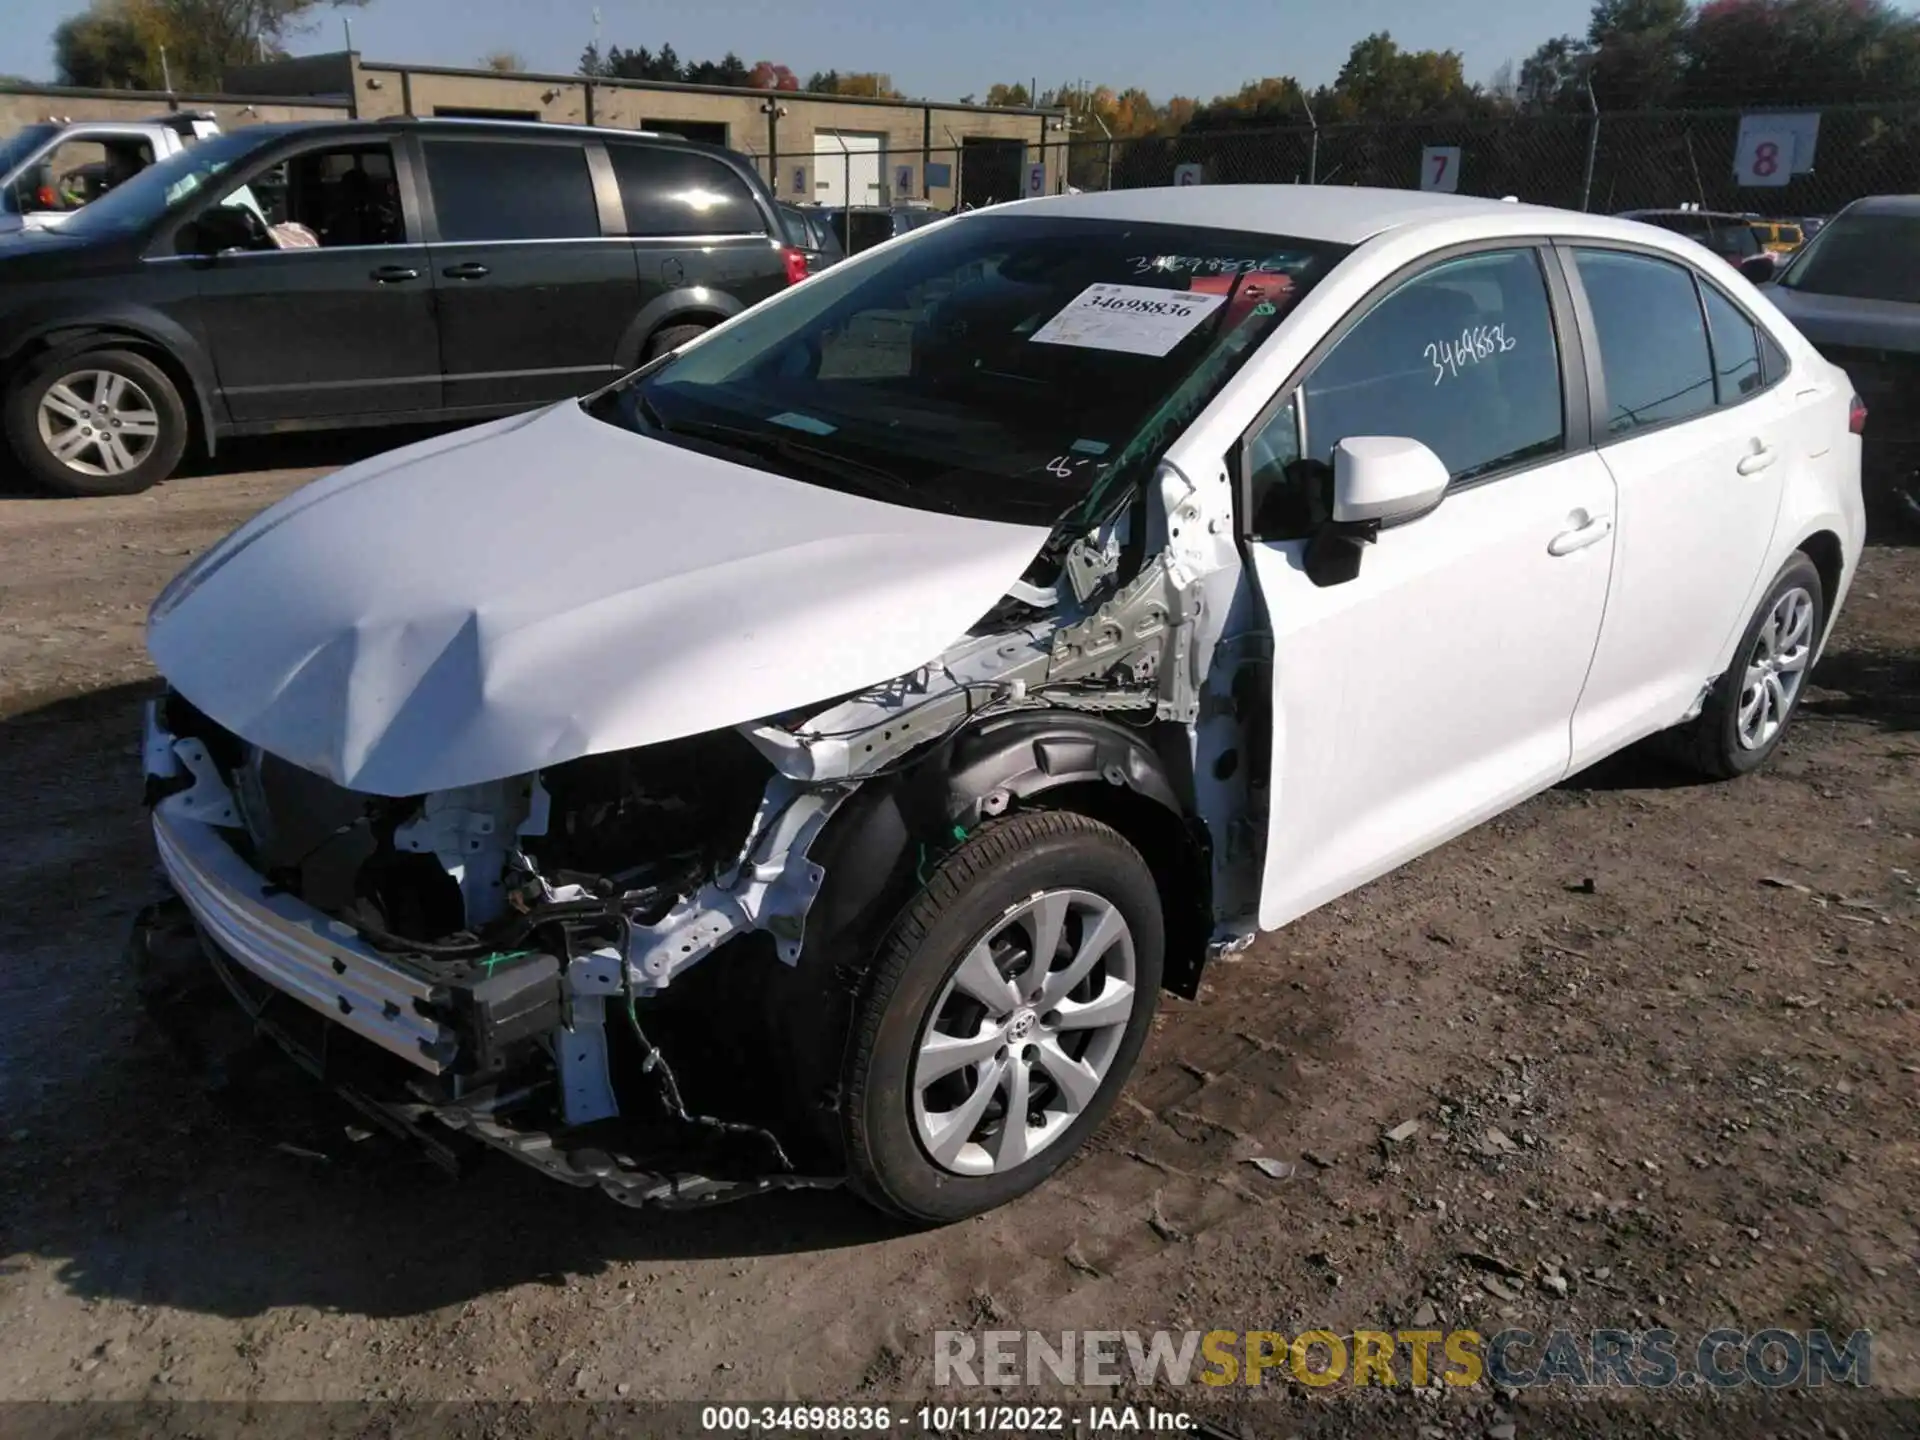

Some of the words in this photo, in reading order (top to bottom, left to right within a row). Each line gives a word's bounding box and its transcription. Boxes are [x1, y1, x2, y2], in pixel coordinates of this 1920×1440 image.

[1432, 155, 1448, 185] 7
[1752, 142, 1779, 177] 8
[900, 170, 908, 192] 4
[1031, 169, 1042, 191] 5
[1083, 295, 1192, 318] 34698836
[1423, 322, 1516, 386] 34698836
